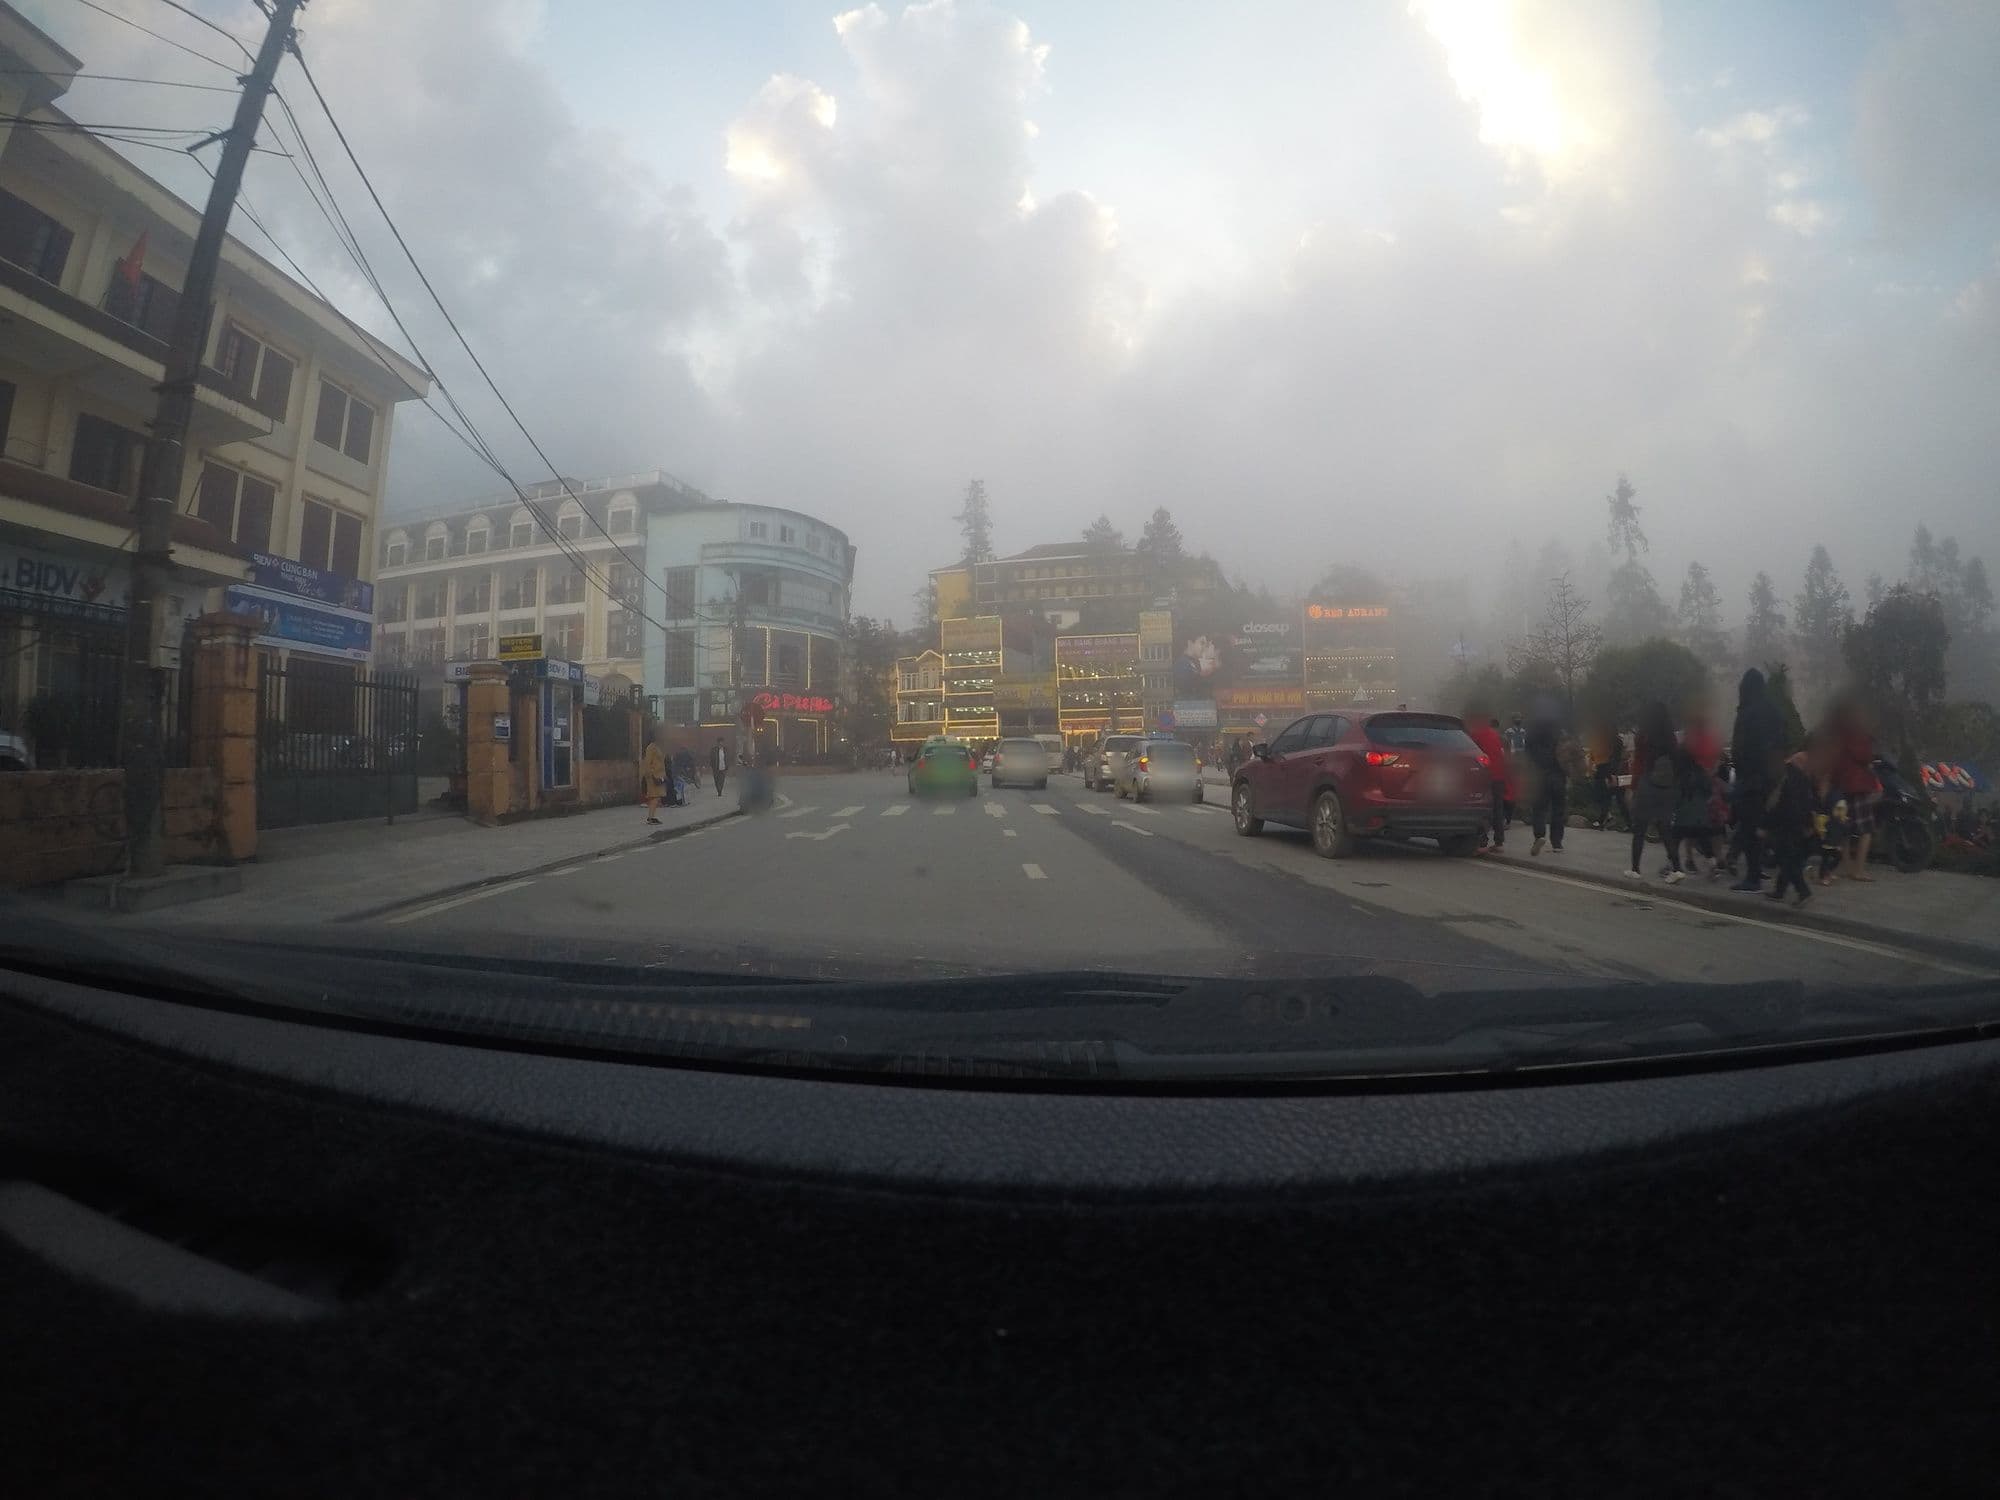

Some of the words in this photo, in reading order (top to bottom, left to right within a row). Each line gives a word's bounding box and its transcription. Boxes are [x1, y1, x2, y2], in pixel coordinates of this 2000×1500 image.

[16, 559, 80, 595] BIDV
[1323, 607, 1390, 618] RESAURANT
[1243, 619, 1290, 637] closeup
